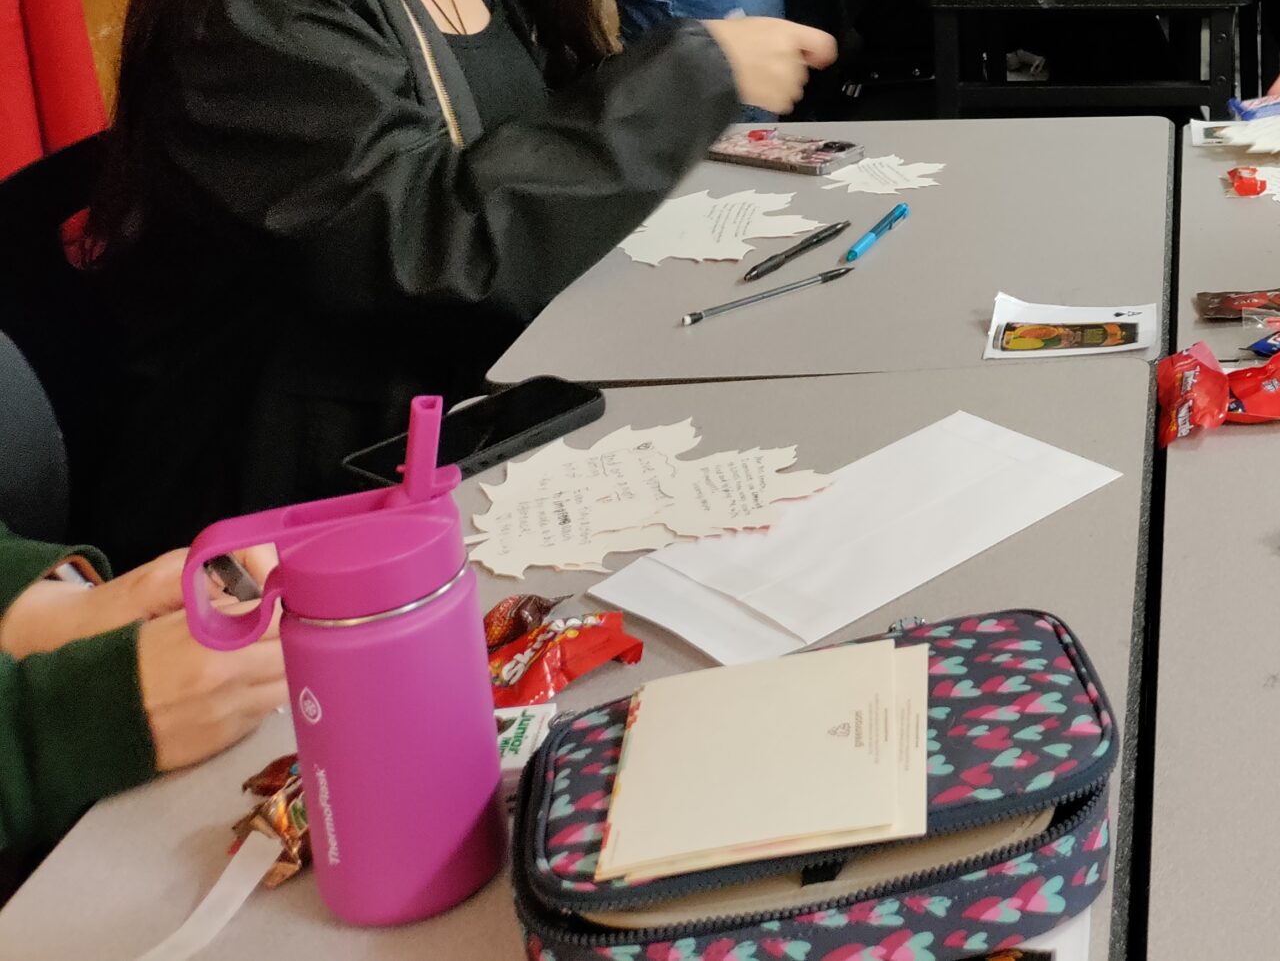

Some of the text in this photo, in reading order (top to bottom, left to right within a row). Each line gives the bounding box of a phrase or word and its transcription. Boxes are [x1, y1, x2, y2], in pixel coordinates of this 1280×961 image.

[510, 710, 535, 756] Junior
[854, 709, 865, 748] greenroom
[315, 767, 341, 866] ThermoFlask
